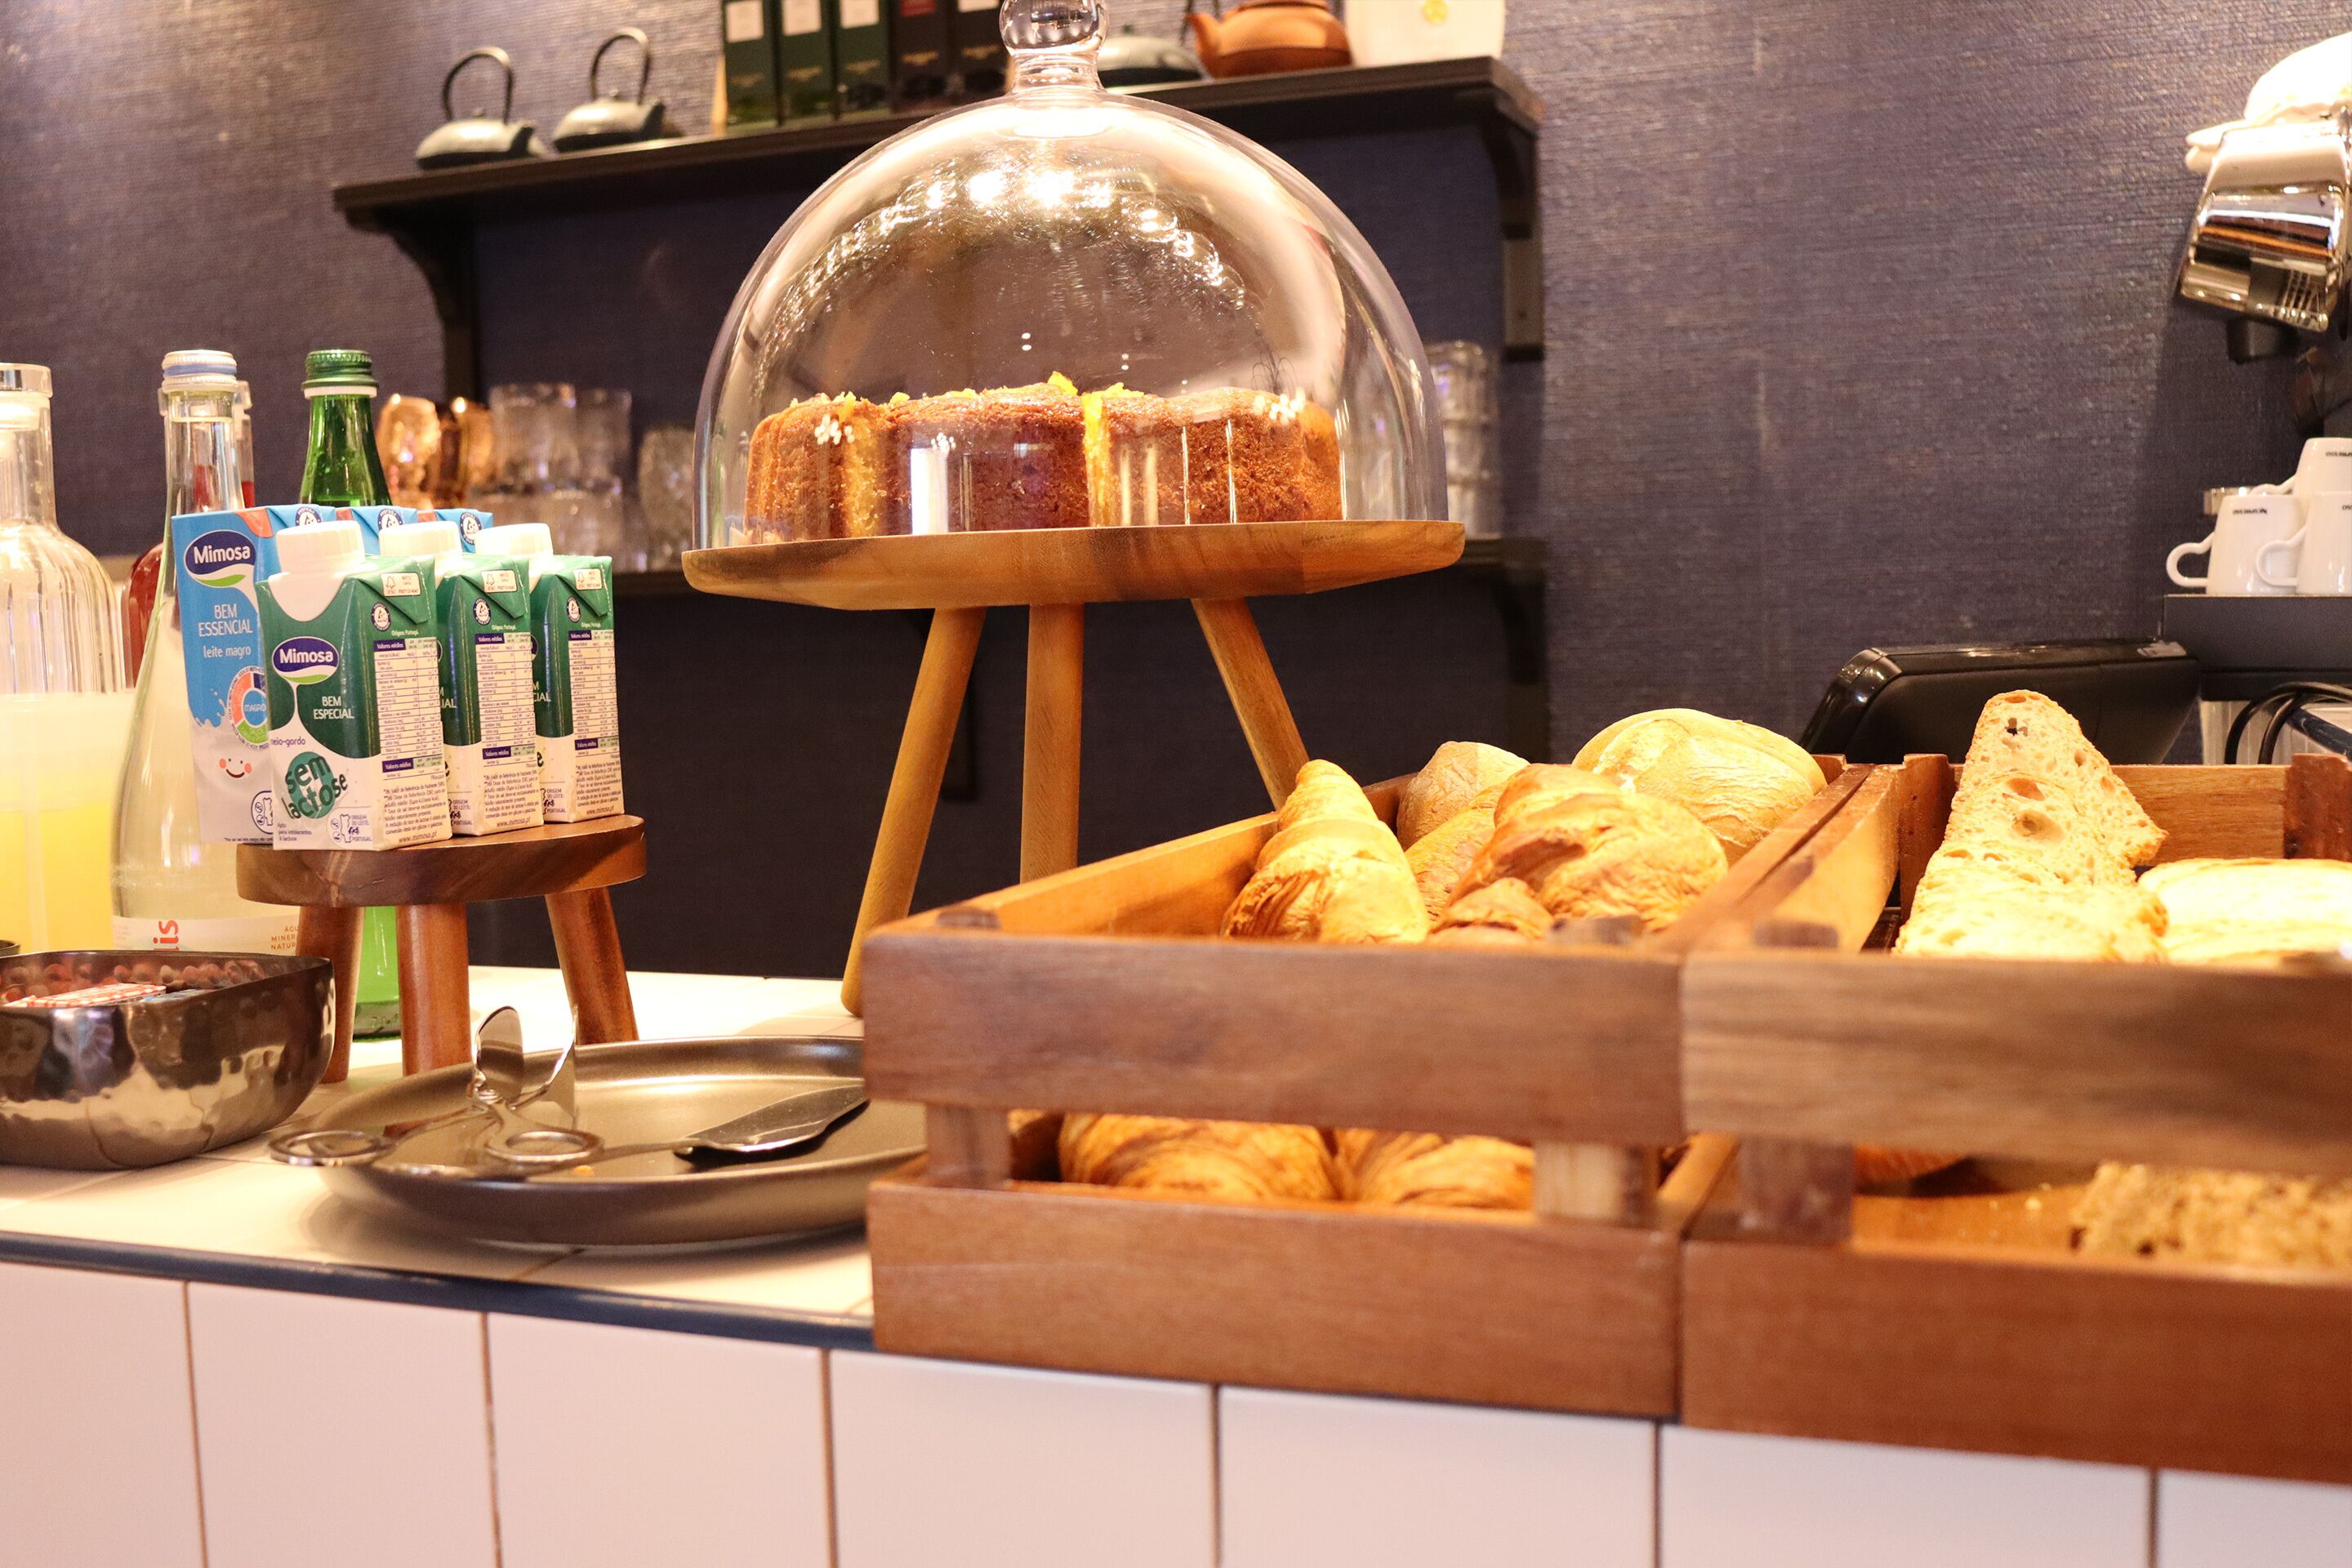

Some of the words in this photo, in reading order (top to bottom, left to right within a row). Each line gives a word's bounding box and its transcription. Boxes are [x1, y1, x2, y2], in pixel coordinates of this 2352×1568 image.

[194, 545, 251, 564] Mimosa
[214, 603, 238, 619] BEM
[198, 620, 254, 638] ESSENCIAL
[203, 645, 223, 659] leite
[225, 644, 252, 660] magro
[279, 649, 334, 665] Mimosa
[244, 702, 267, 713] MAGRO
[322, 695, 341, 706] BEM
[313, 708, 354, 719] ESPECIAL
[285, 755, 332, 795] sem
[281, 773, 349, 819] lactose
[270, 933, 296, 942] MINER
[270, 942, 296, 950] NATUR
